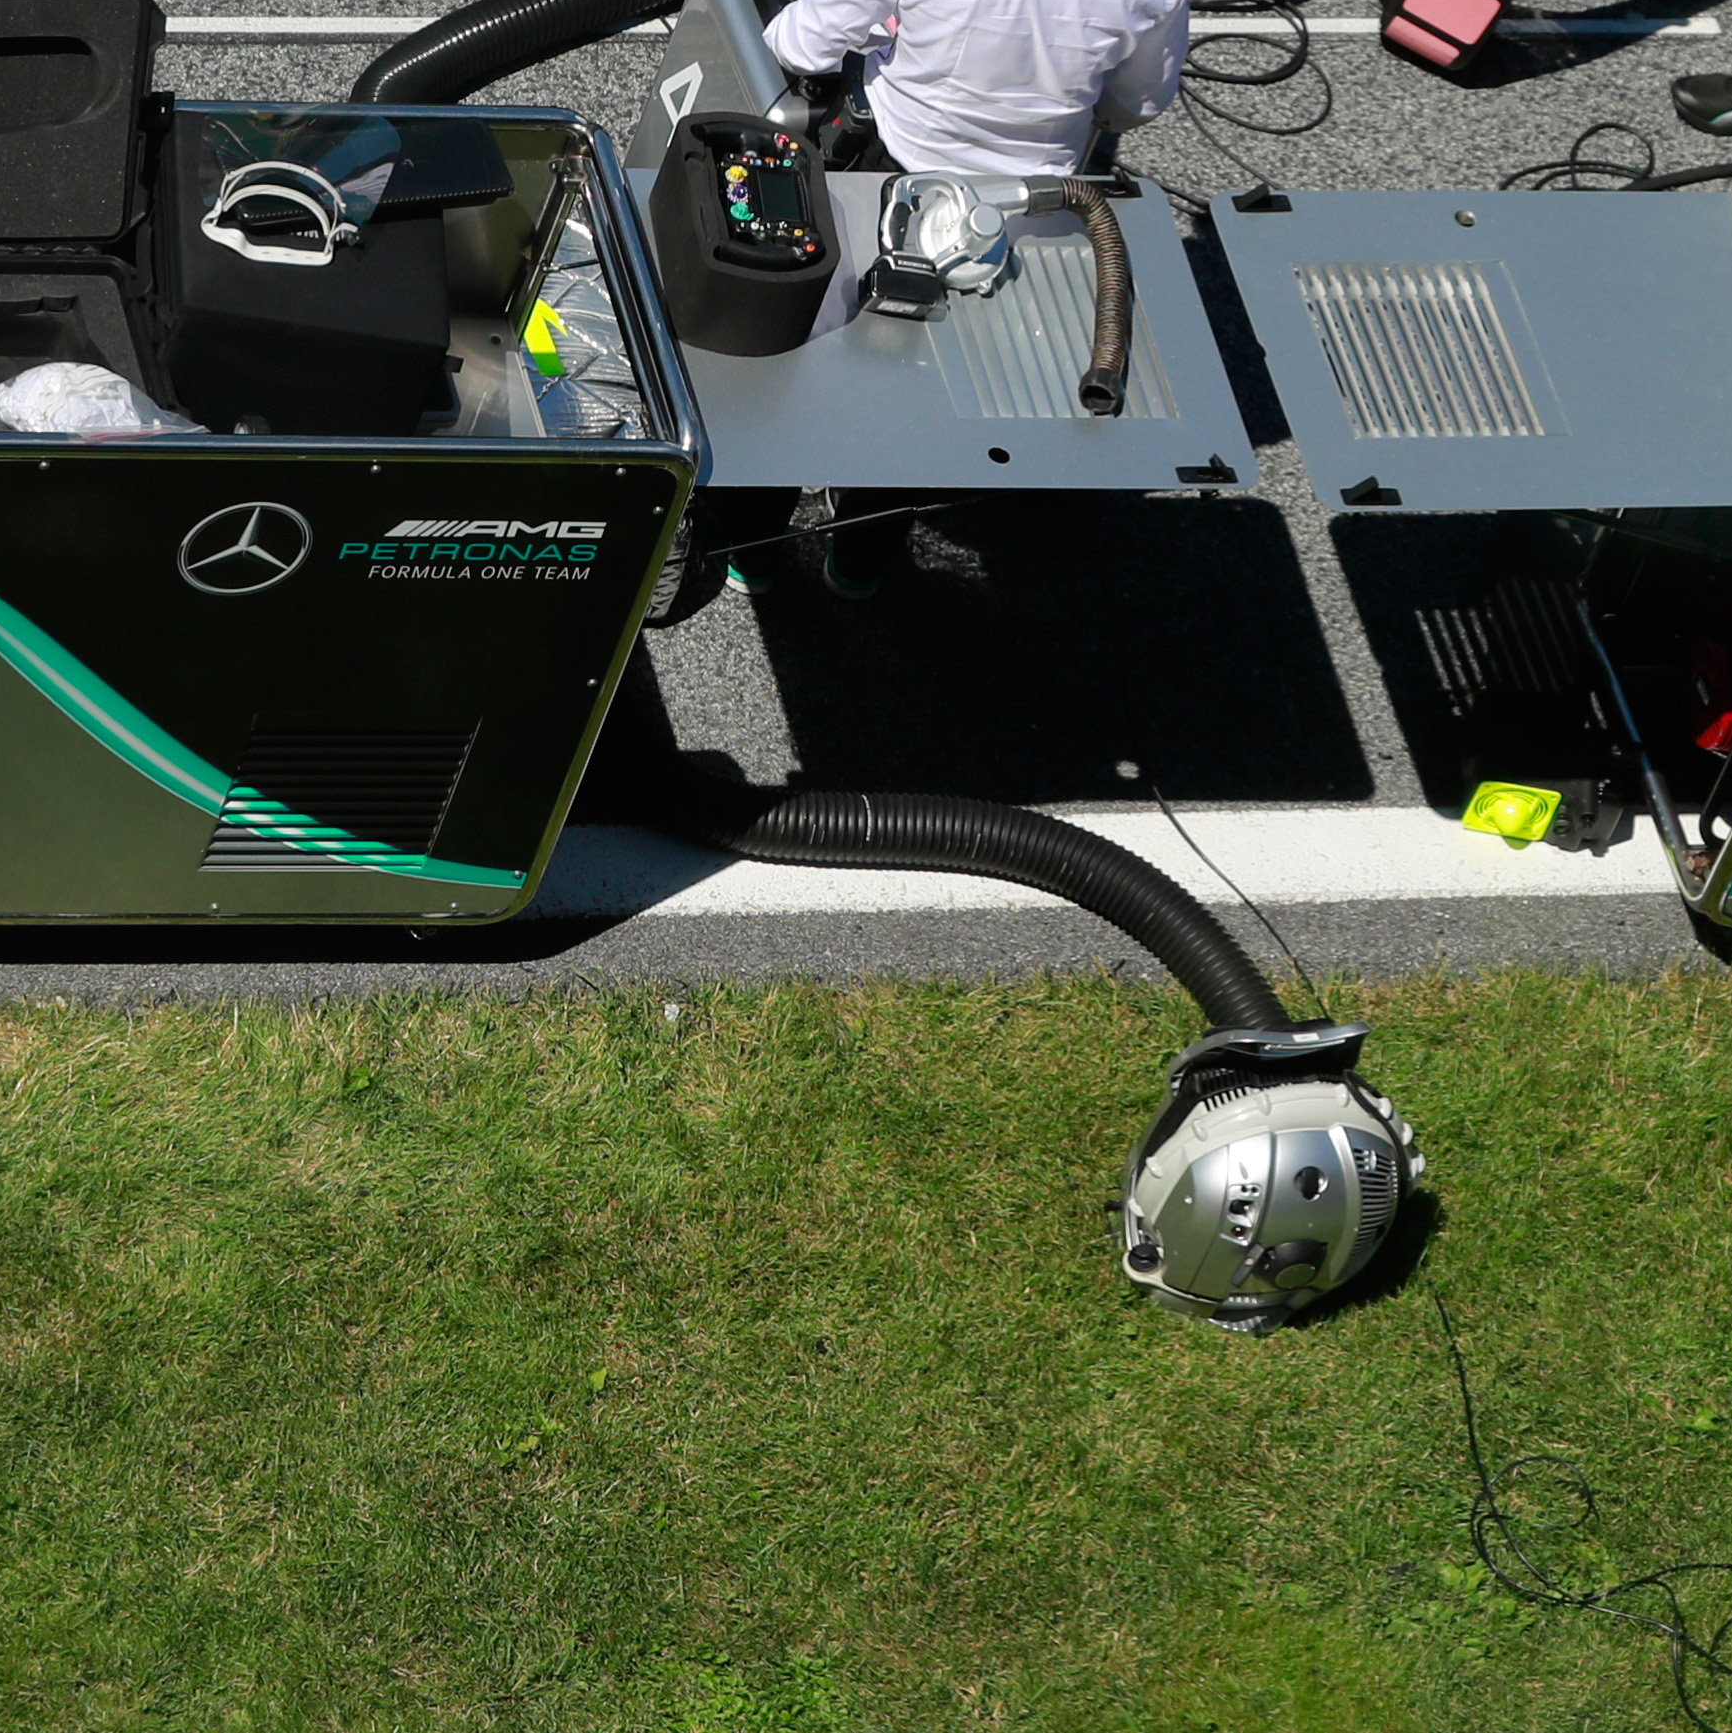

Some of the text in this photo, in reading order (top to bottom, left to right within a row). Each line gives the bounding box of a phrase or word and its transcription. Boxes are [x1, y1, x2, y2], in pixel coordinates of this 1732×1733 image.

[454, 519, 608, 539] AMG
[339, 542, 598, 562] PETRONAS
[368, 565, 591, 581] FORMULA ONE TEAM
